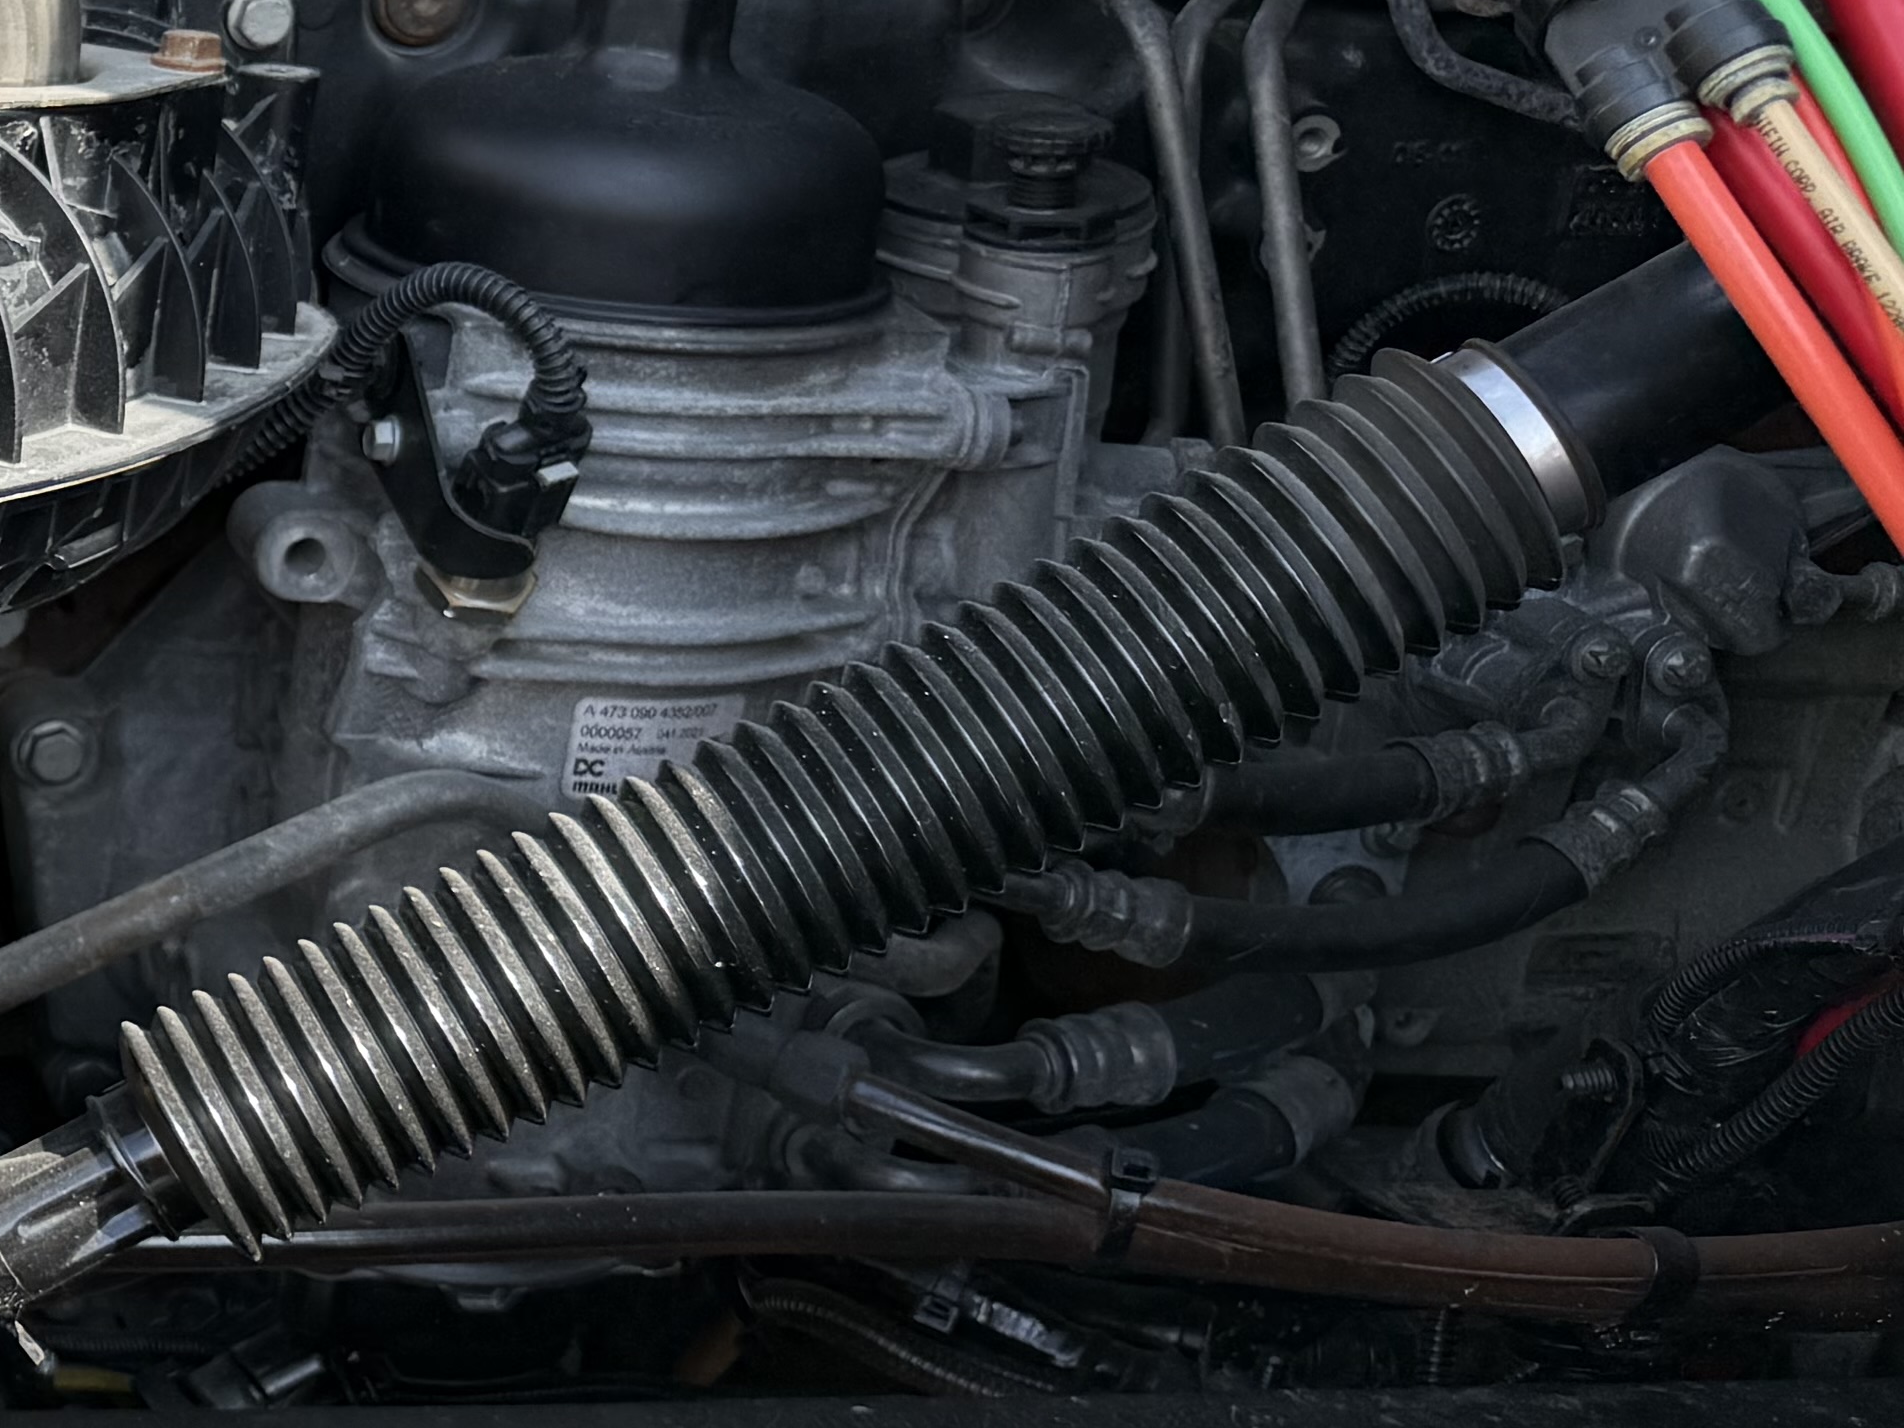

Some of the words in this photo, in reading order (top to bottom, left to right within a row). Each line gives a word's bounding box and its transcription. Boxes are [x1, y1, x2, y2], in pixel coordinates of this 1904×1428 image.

[1819, 208, 1845, 236] AIR
[583, 704, 596, 718] A
[600, 704, 627, 719] 473
[631, 704, 656, 719] 090
[580, 725, 641, 741] 0000057
[573, 758, 605, 776] DC
